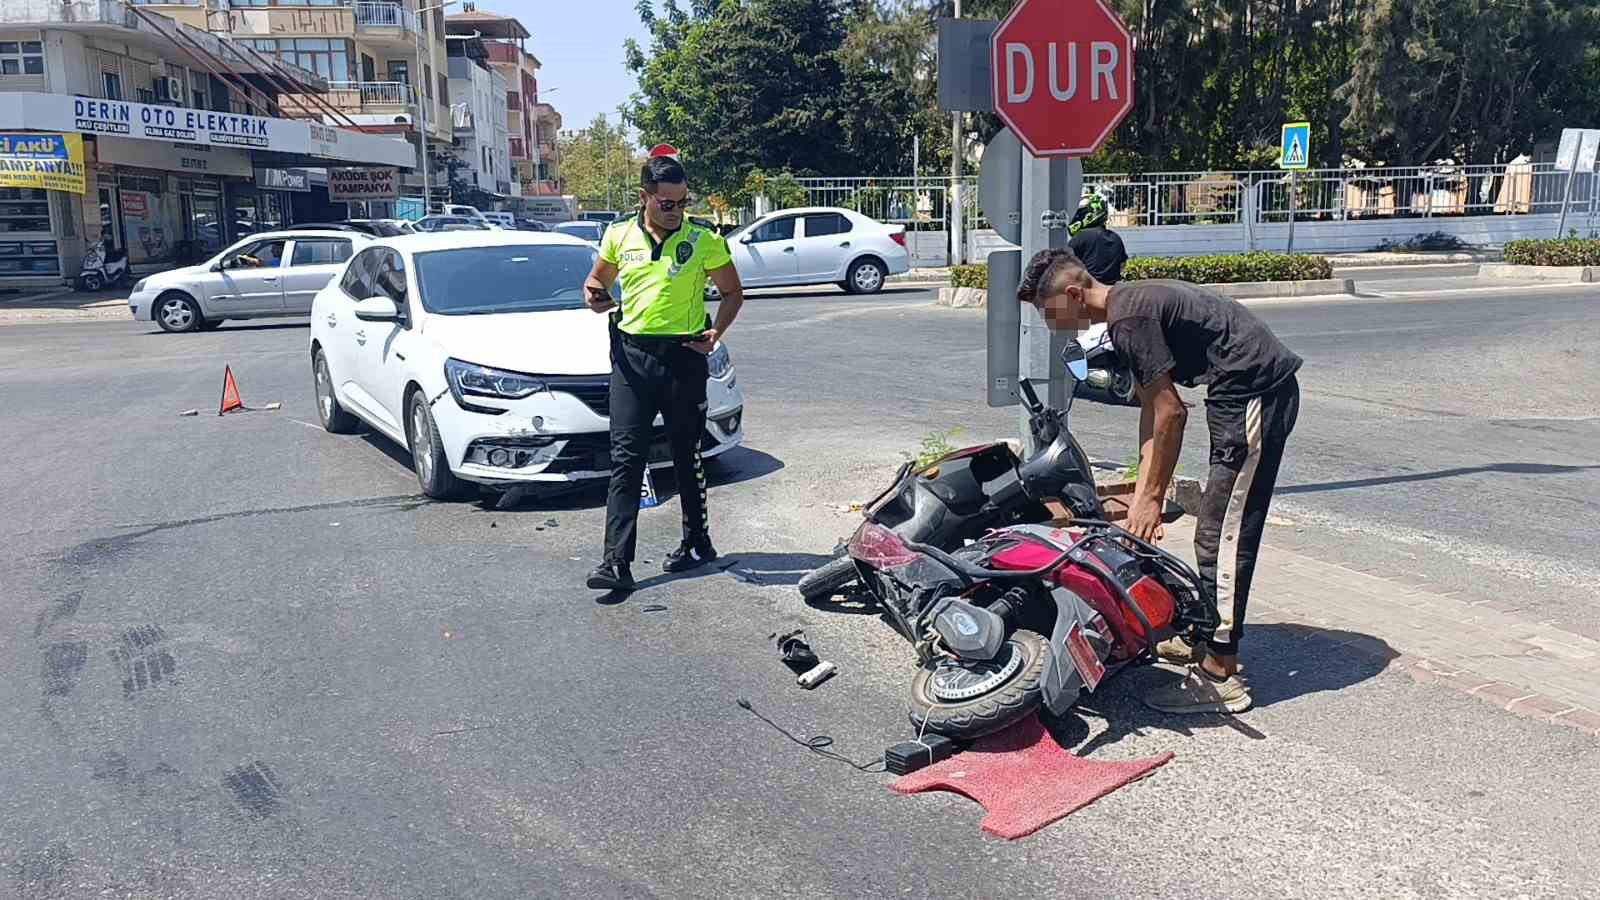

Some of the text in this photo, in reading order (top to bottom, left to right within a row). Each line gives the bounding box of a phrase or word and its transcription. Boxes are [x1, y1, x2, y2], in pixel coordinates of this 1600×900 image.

[1005, 41, 1119, 103] DUR
[141, 107, 175, 126] OTO
[333, 183, 393, 194] KAMPANYA
